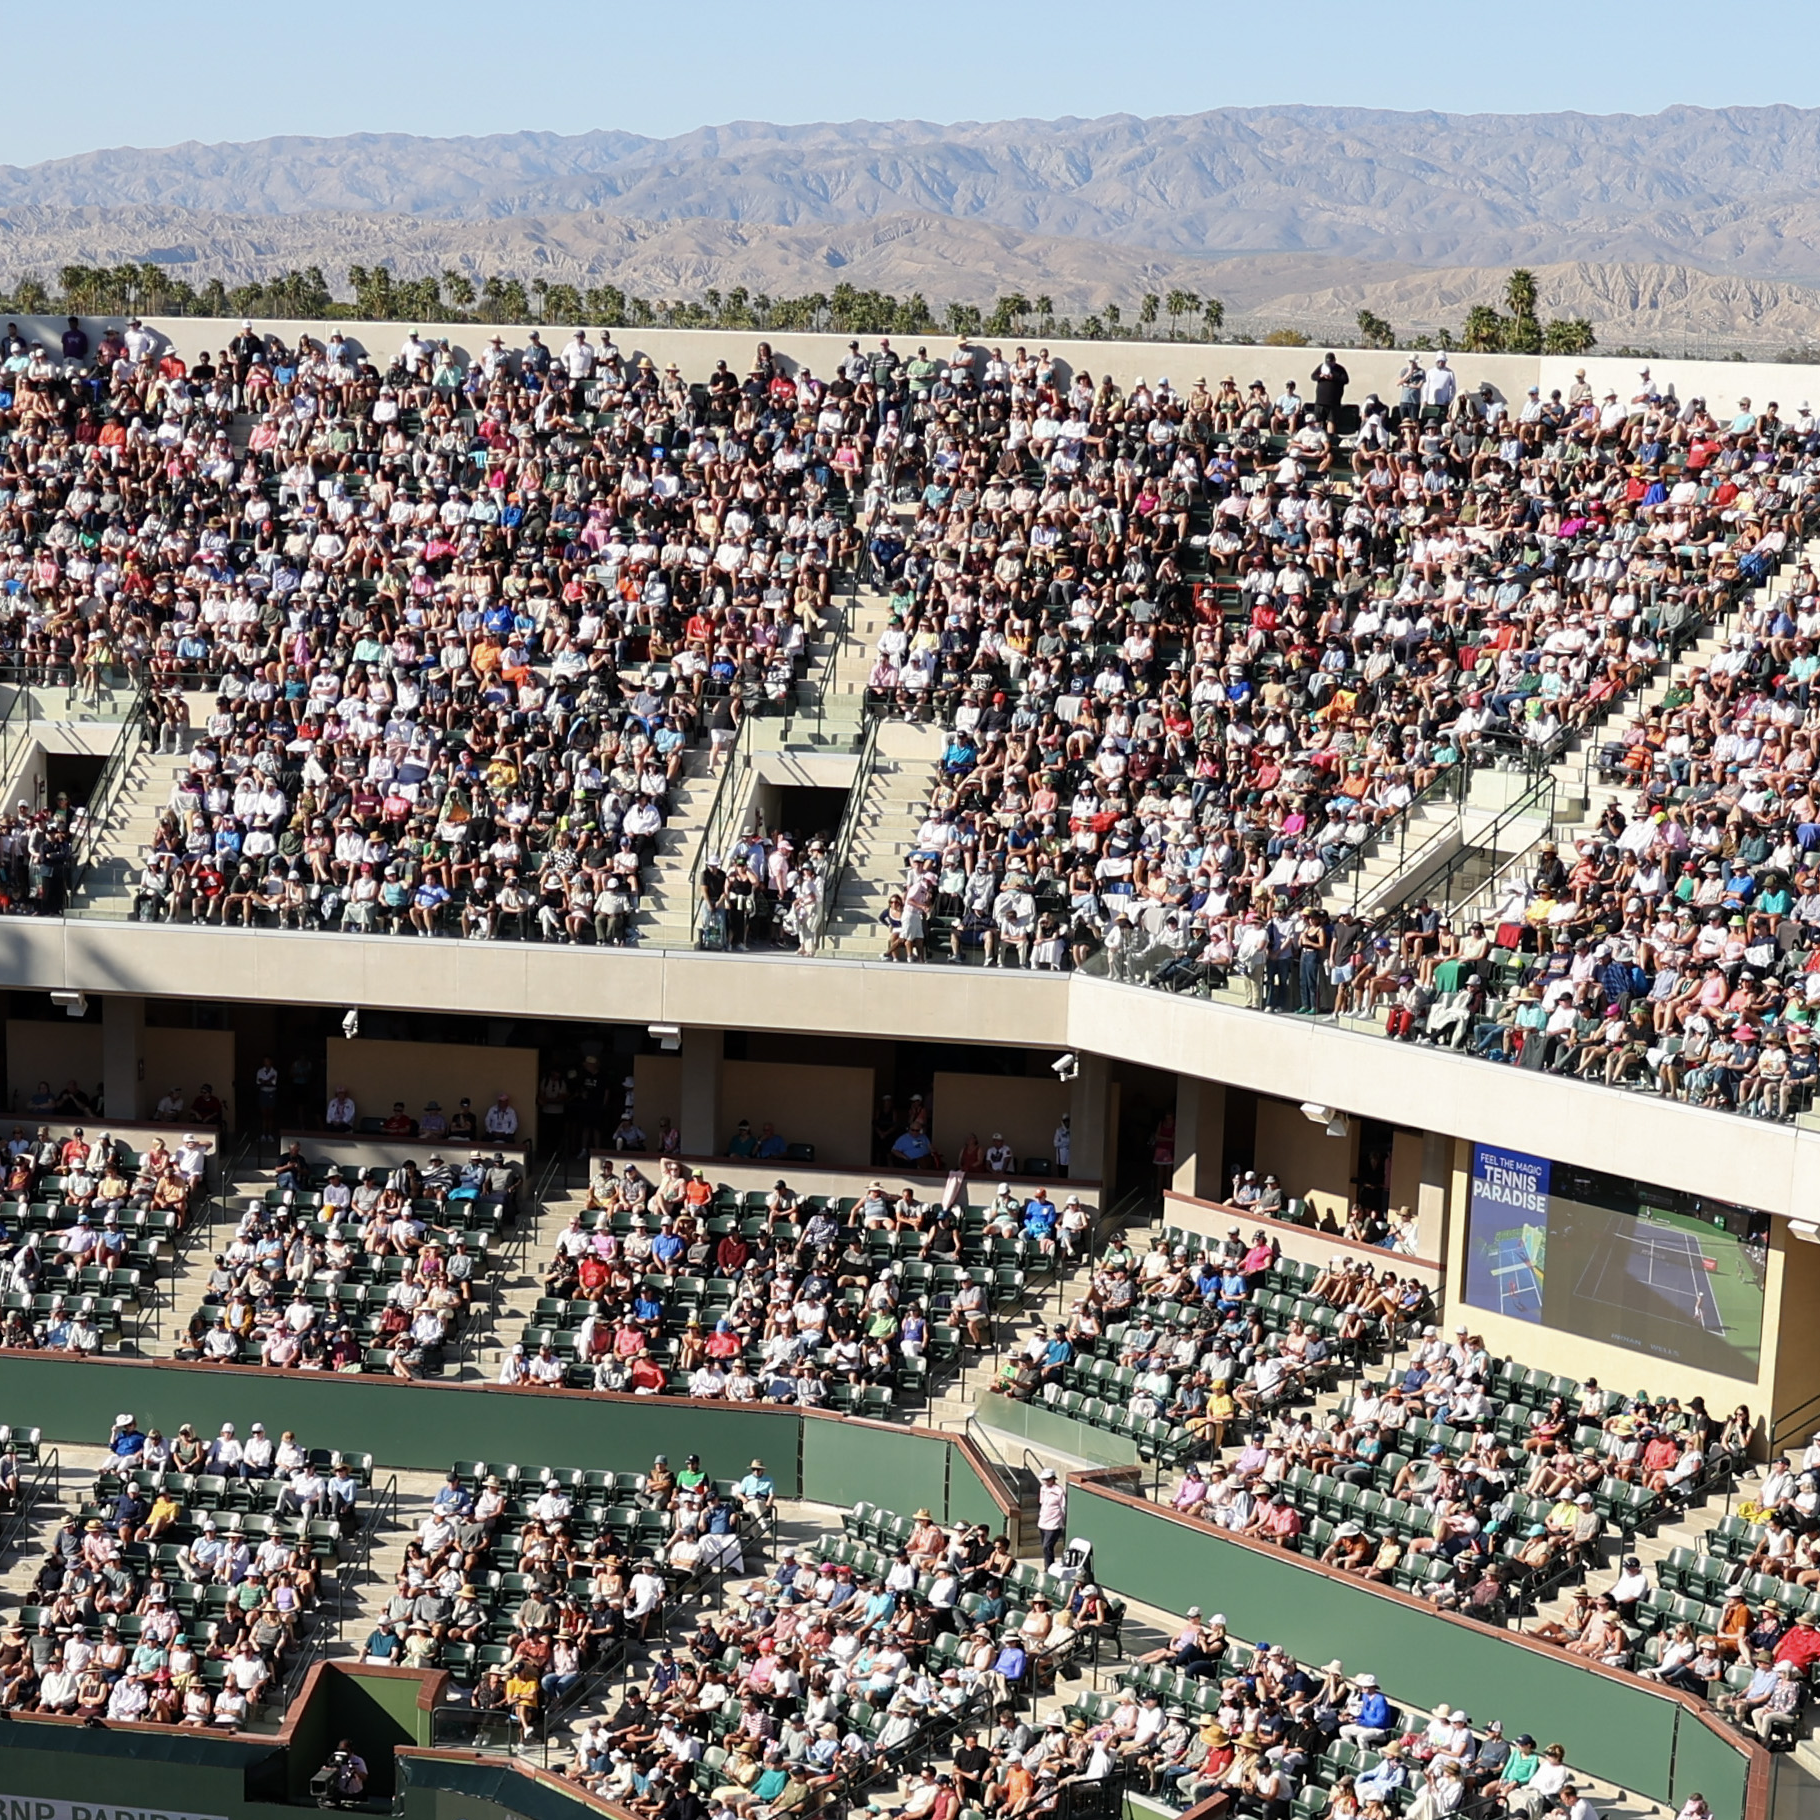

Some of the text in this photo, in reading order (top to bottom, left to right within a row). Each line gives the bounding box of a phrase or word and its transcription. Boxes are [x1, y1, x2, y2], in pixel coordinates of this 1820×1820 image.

[1480, 1152, 1543, 1176] FEEL THE MAGIC
[1484, 1164, 1537, 1193] TENNIS
[1473, 1180, 1546, 1214] PARADISE
